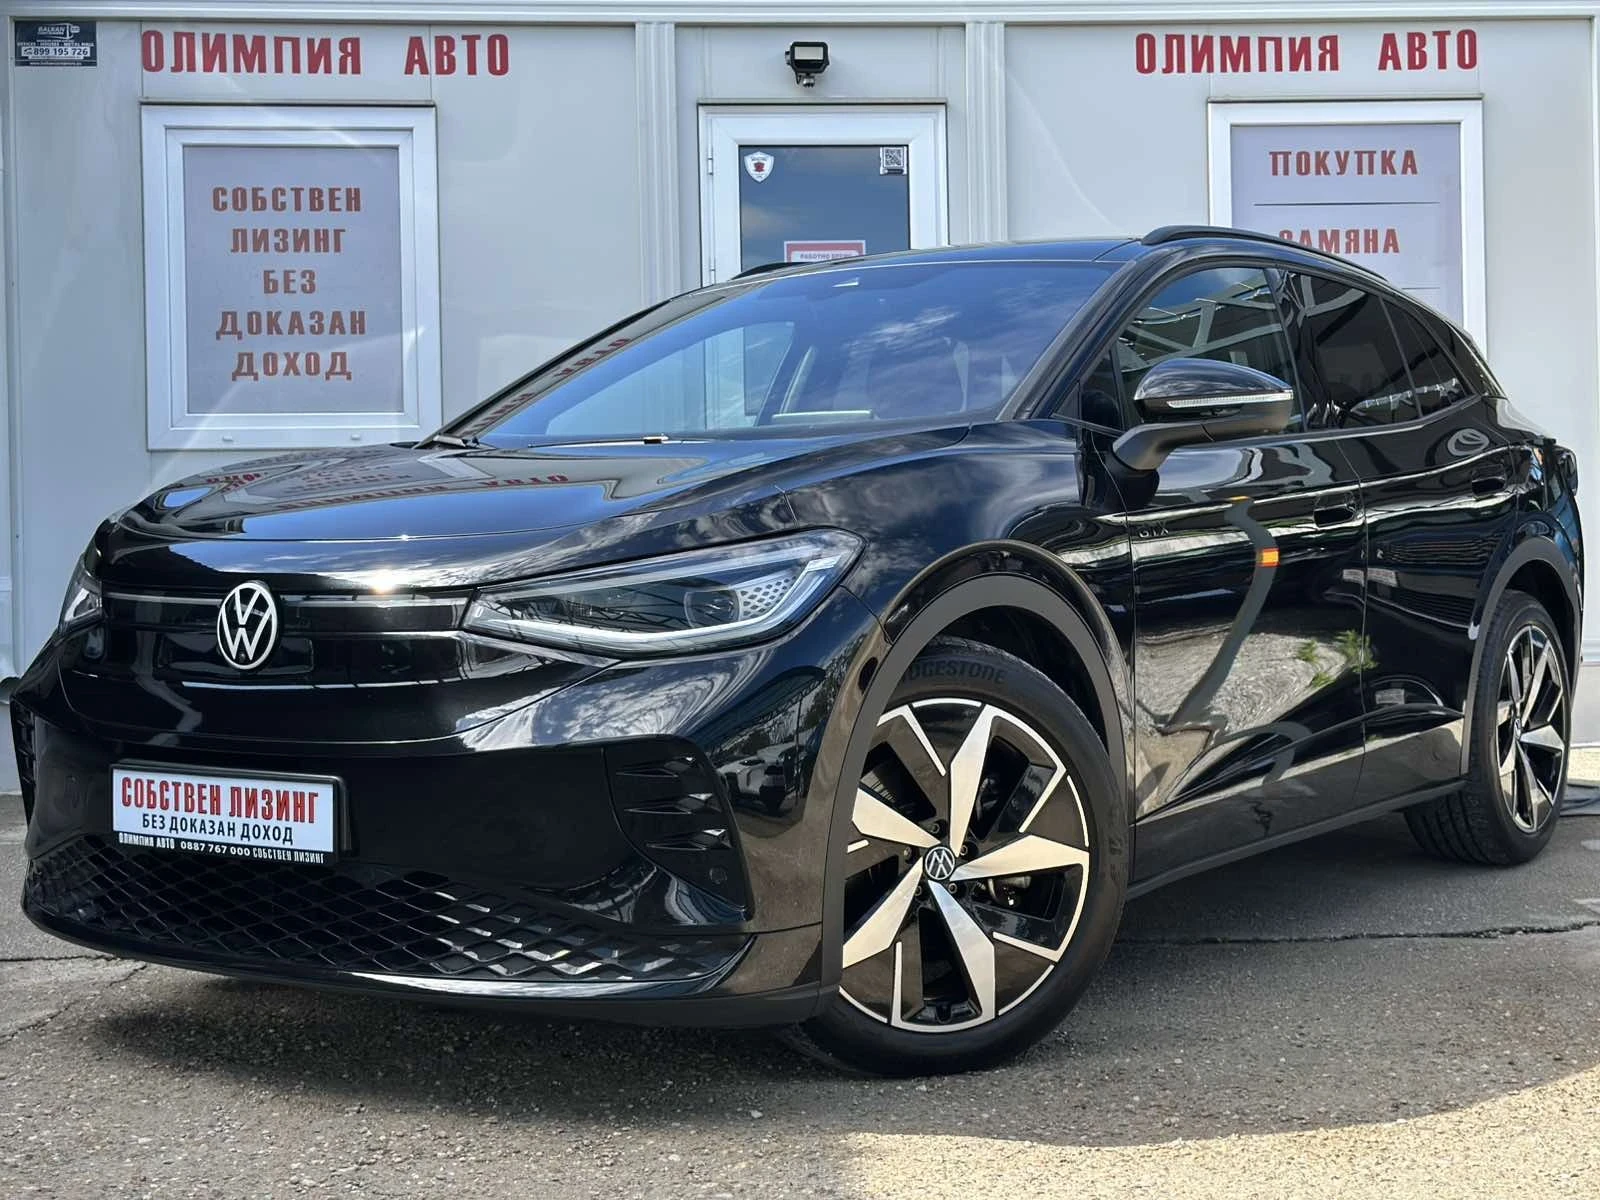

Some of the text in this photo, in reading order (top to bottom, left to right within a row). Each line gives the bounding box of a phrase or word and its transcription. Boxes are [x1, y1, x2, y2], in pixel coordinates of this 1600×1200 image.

[53, 48, 69, 56] 195
[71, 48, 88, 56] 726
[142, 30, 511, 77] ОЛИМПИЯ АВТО
[1134, 28, 1479, 76] ОЛИМПИЯ АВТО
[1269, 149, 1419, 177] ПОКУПКА
[211, 186, 363, 213] СОБСТВЕН
[230, 228, 347, 254] ЛИЗИНГ
[263, 269, 317, 295] БЕЗ
[216, 310, 367, 341] ДОКАЗАН
[231, 351, 353, 382] ДОХОД
[121, 776, 319, 824] СОБСТВЕН ЛИЗИНГ
[142, 813, 293, 846] БЕЗ ДОКАЗАН ДОХОД
[118, 832, 325, 864] ОЛИМПИЯ АВТО 0887 767 000 СОБСТВЕН ЛИЗИНГ
